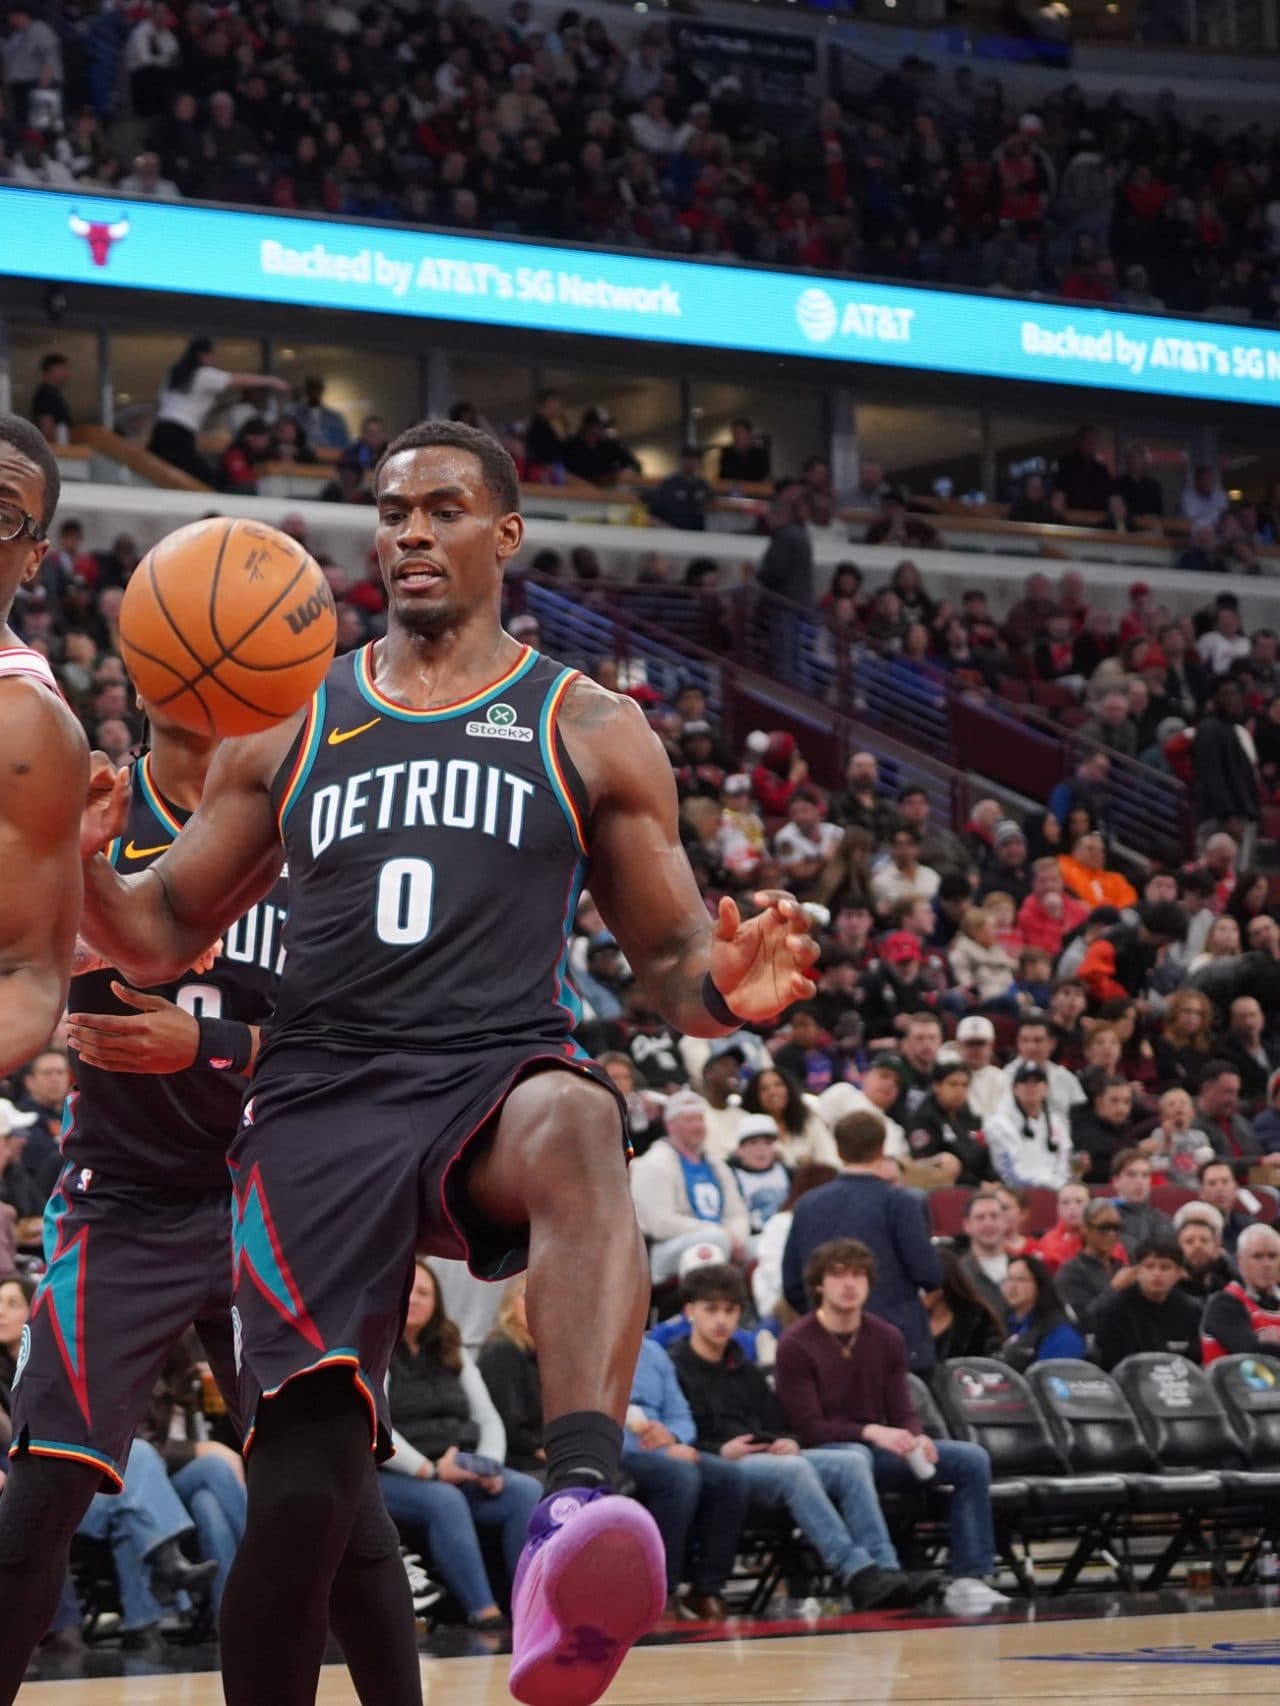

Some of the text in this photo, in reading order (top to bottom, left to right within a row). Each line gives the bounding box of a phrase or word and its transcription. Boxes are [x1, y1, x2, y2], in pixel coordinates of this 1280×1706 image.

[260, 239, 682, 316] Backed by AT&T's 5G Network
[840, 302, 915, 341] AT&T
[1021, 320, 1113, 363] Backed
[1115, 330, 1148, 375] by
[1150, 336, 1229, 376] AT&T's
[1232, 346, 1265, 380] 5G
[468, 723, 532, 740] StockX
[310, 759, 536, 860] DETROIT
[375, 855, 434, 946] 0
